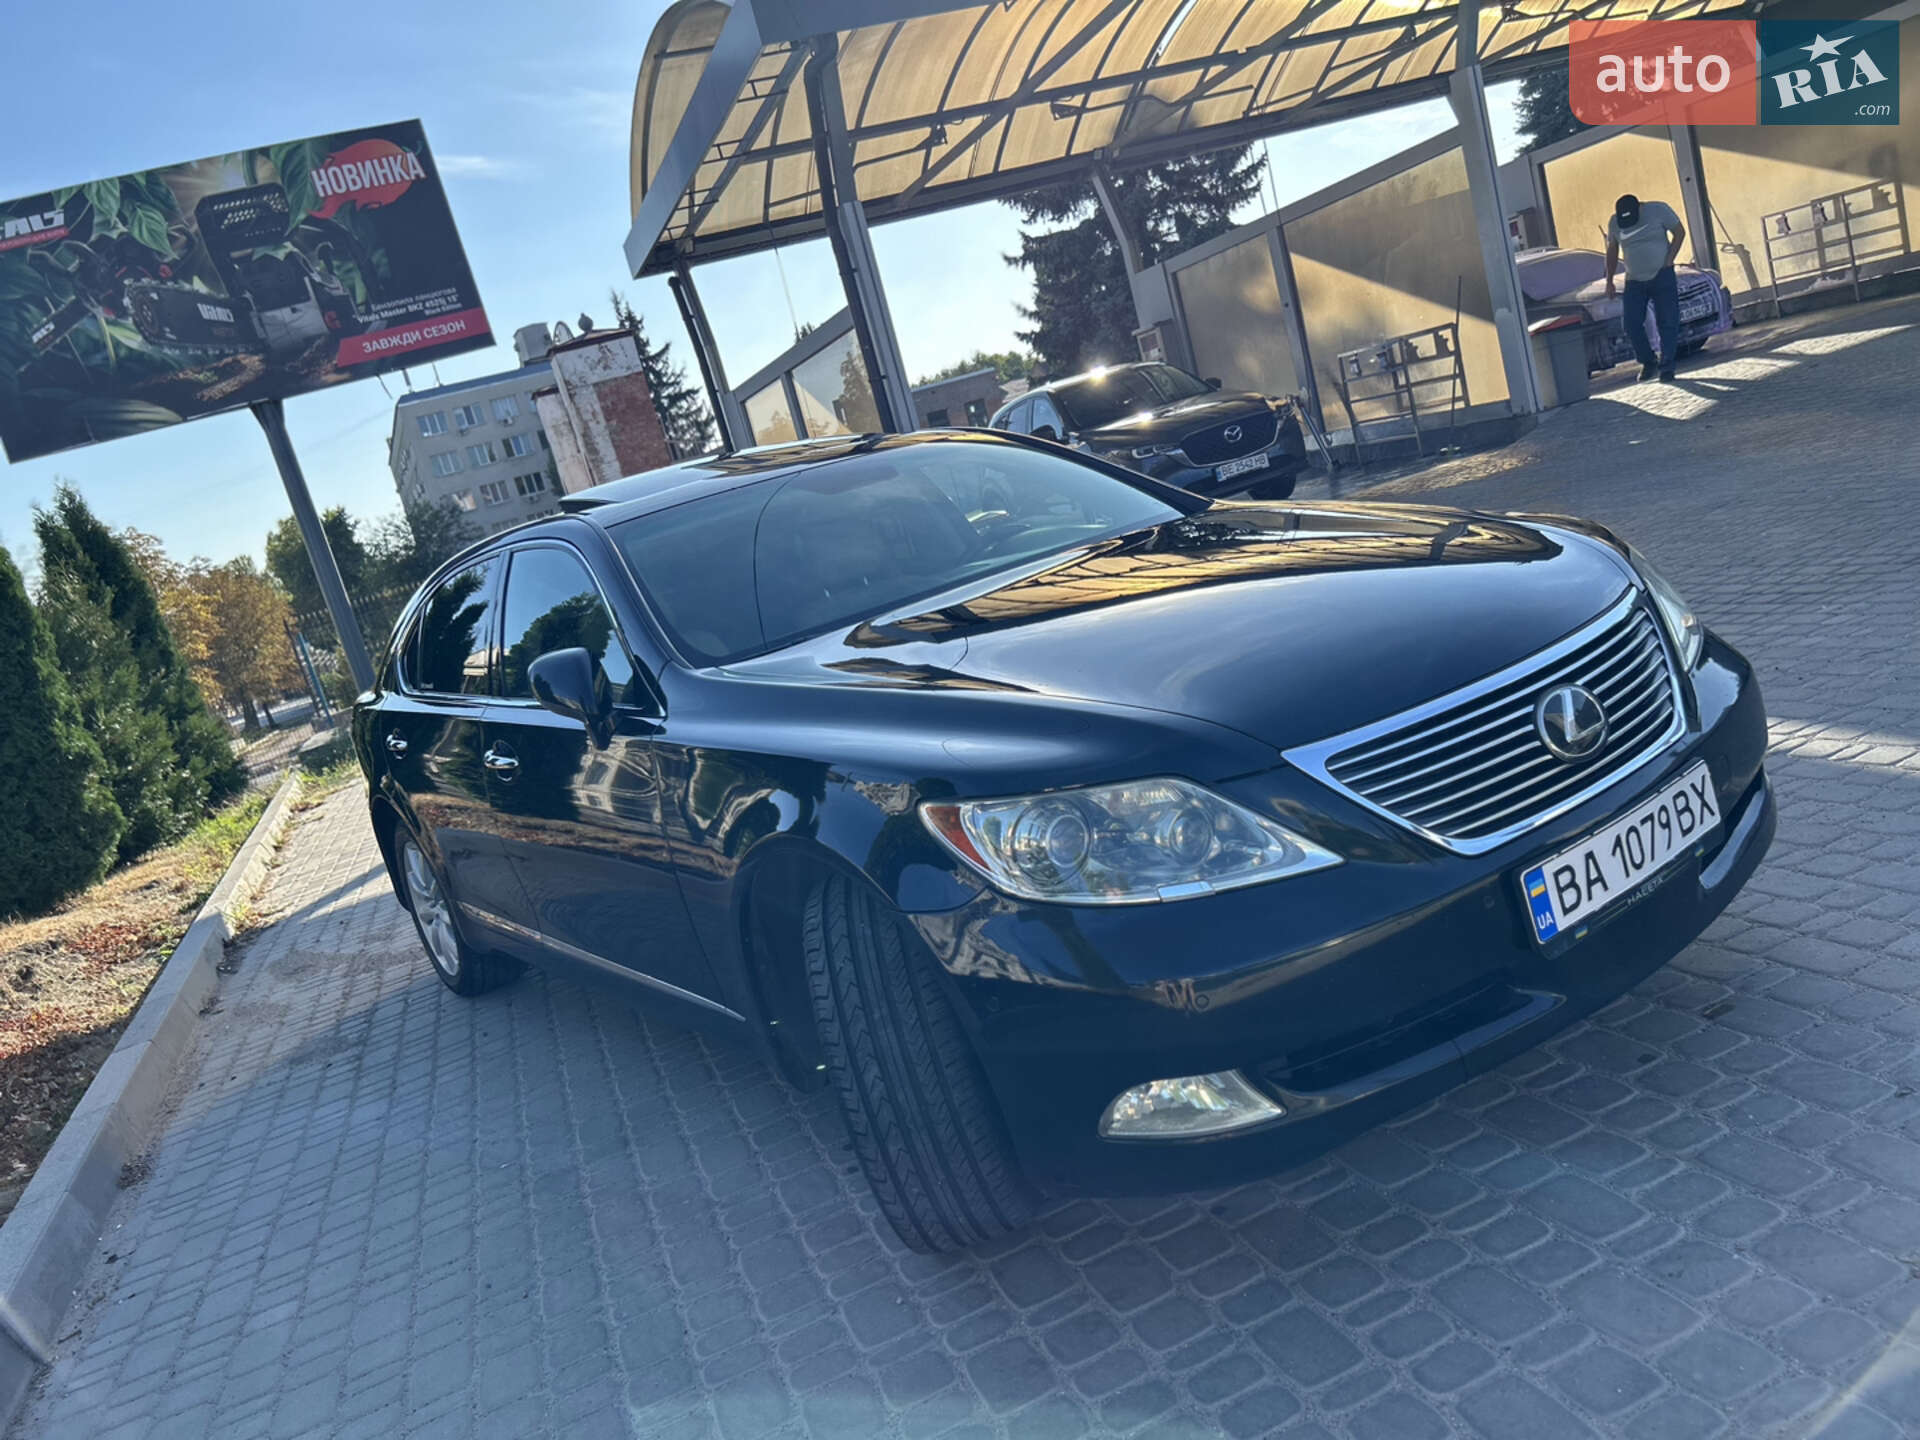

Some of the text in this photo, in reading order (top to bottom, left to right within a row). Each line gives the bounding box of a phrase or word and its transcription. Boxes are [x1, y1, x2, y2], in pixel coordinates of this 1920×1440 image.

[311, 151, 426, 198] НОВИНКА
[362, 319, 467, 354] ЗАВЖДИ СЕЗОН
[1552, 850, 1609, 916] BA
[1536, 911, 1555, 930] UA
